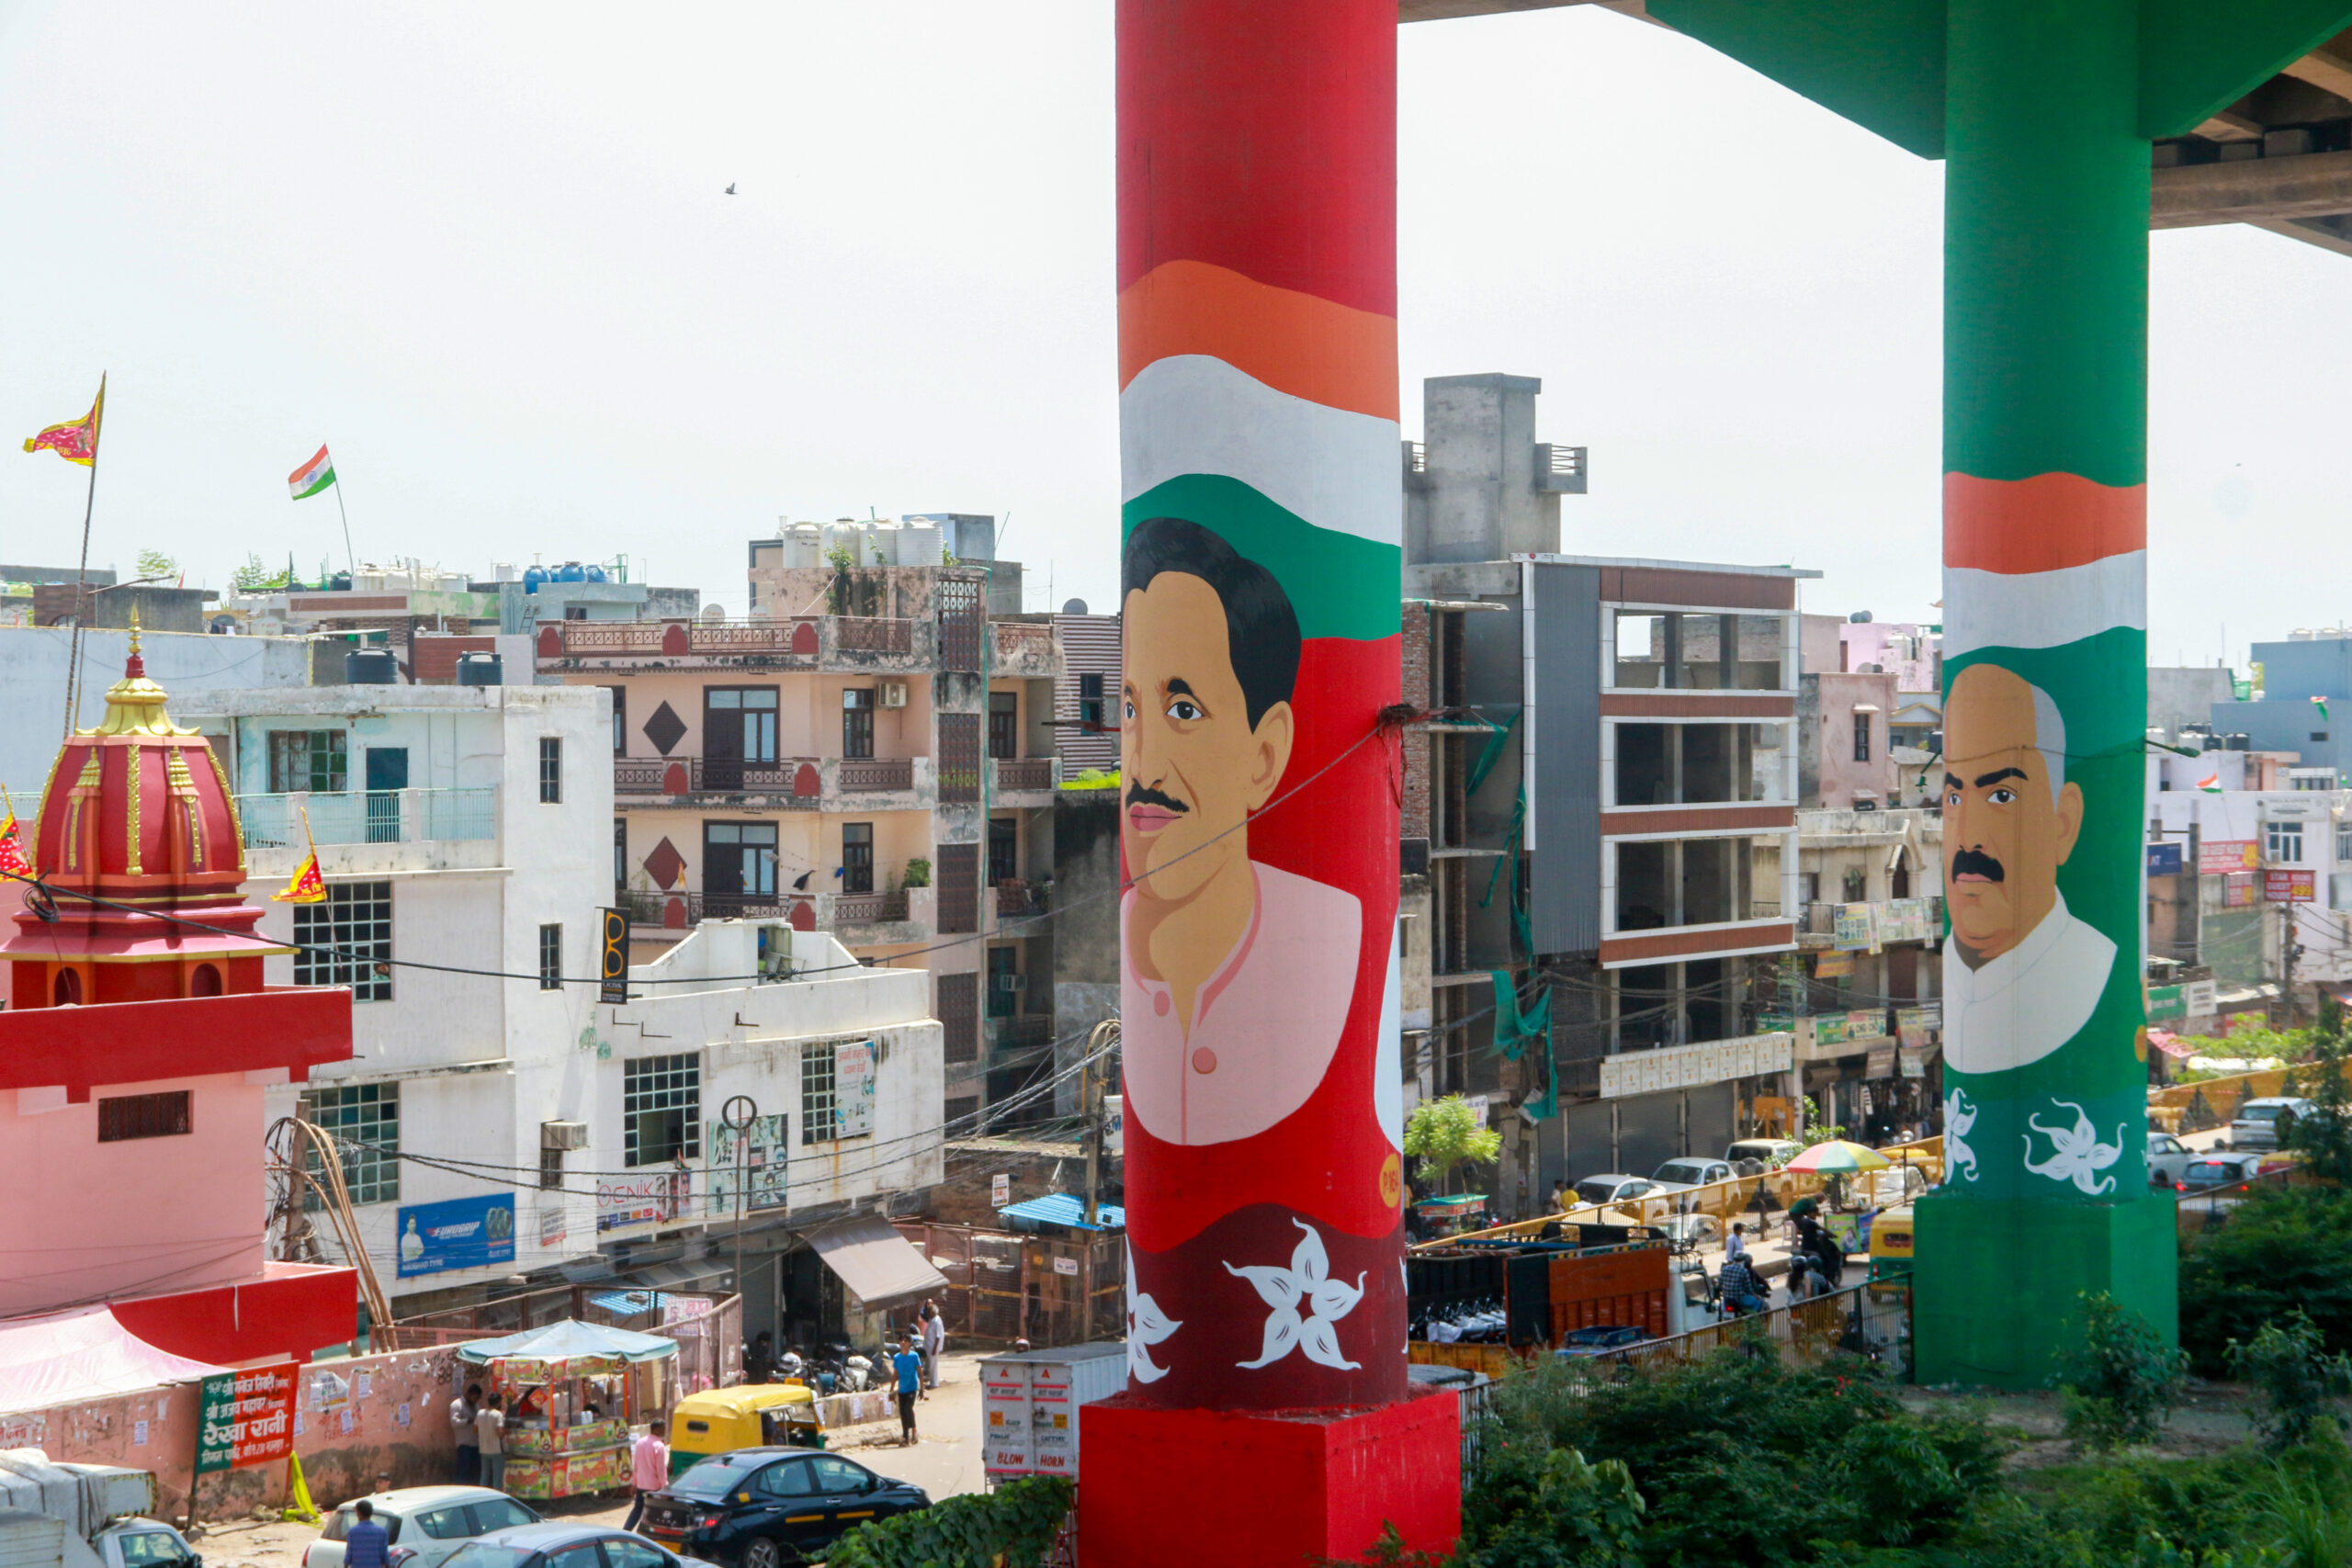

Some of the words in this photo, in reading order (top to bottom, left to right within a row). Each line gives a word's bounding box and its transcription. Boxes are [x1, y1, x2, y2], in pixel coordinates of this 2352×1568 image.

[203, 1422, 248, 1446] रेखा
[251, 1409, 288, 1437] रानी
[997, 1452, 1023, 1464] BLOW
[1040, 1455, 1064, 1467] HORN
